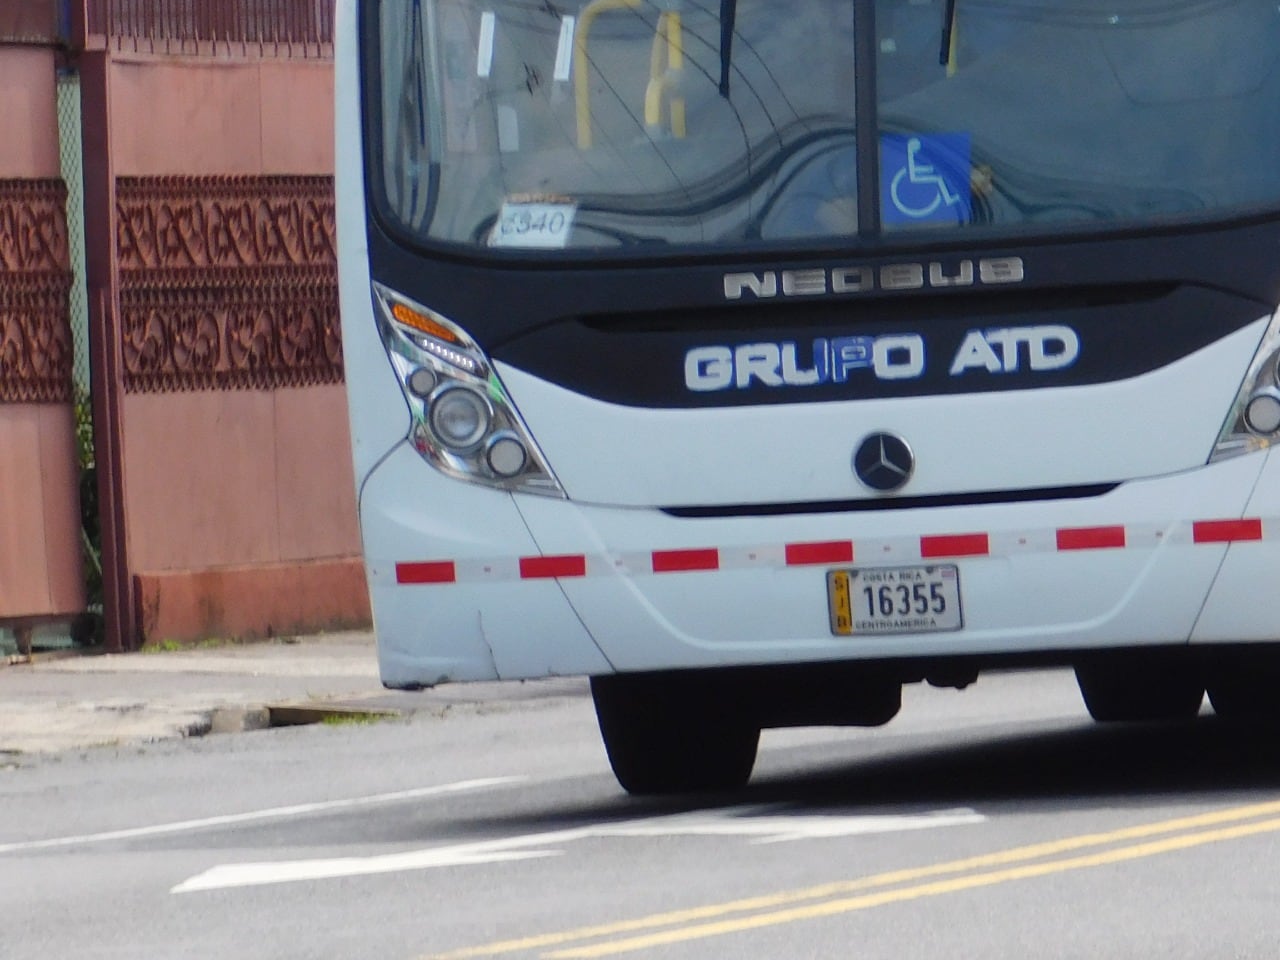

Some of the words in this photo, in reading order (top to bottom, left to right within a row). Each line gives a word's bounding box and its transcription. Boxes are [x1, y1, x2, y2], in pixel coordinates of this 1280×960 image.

[723, 256, 1024, 300] NEOBUS
[684, 332, 925, 392] GRUPO
[949, 324, 1080, 377] ATD
[863, 582, 946, 618] 16355
